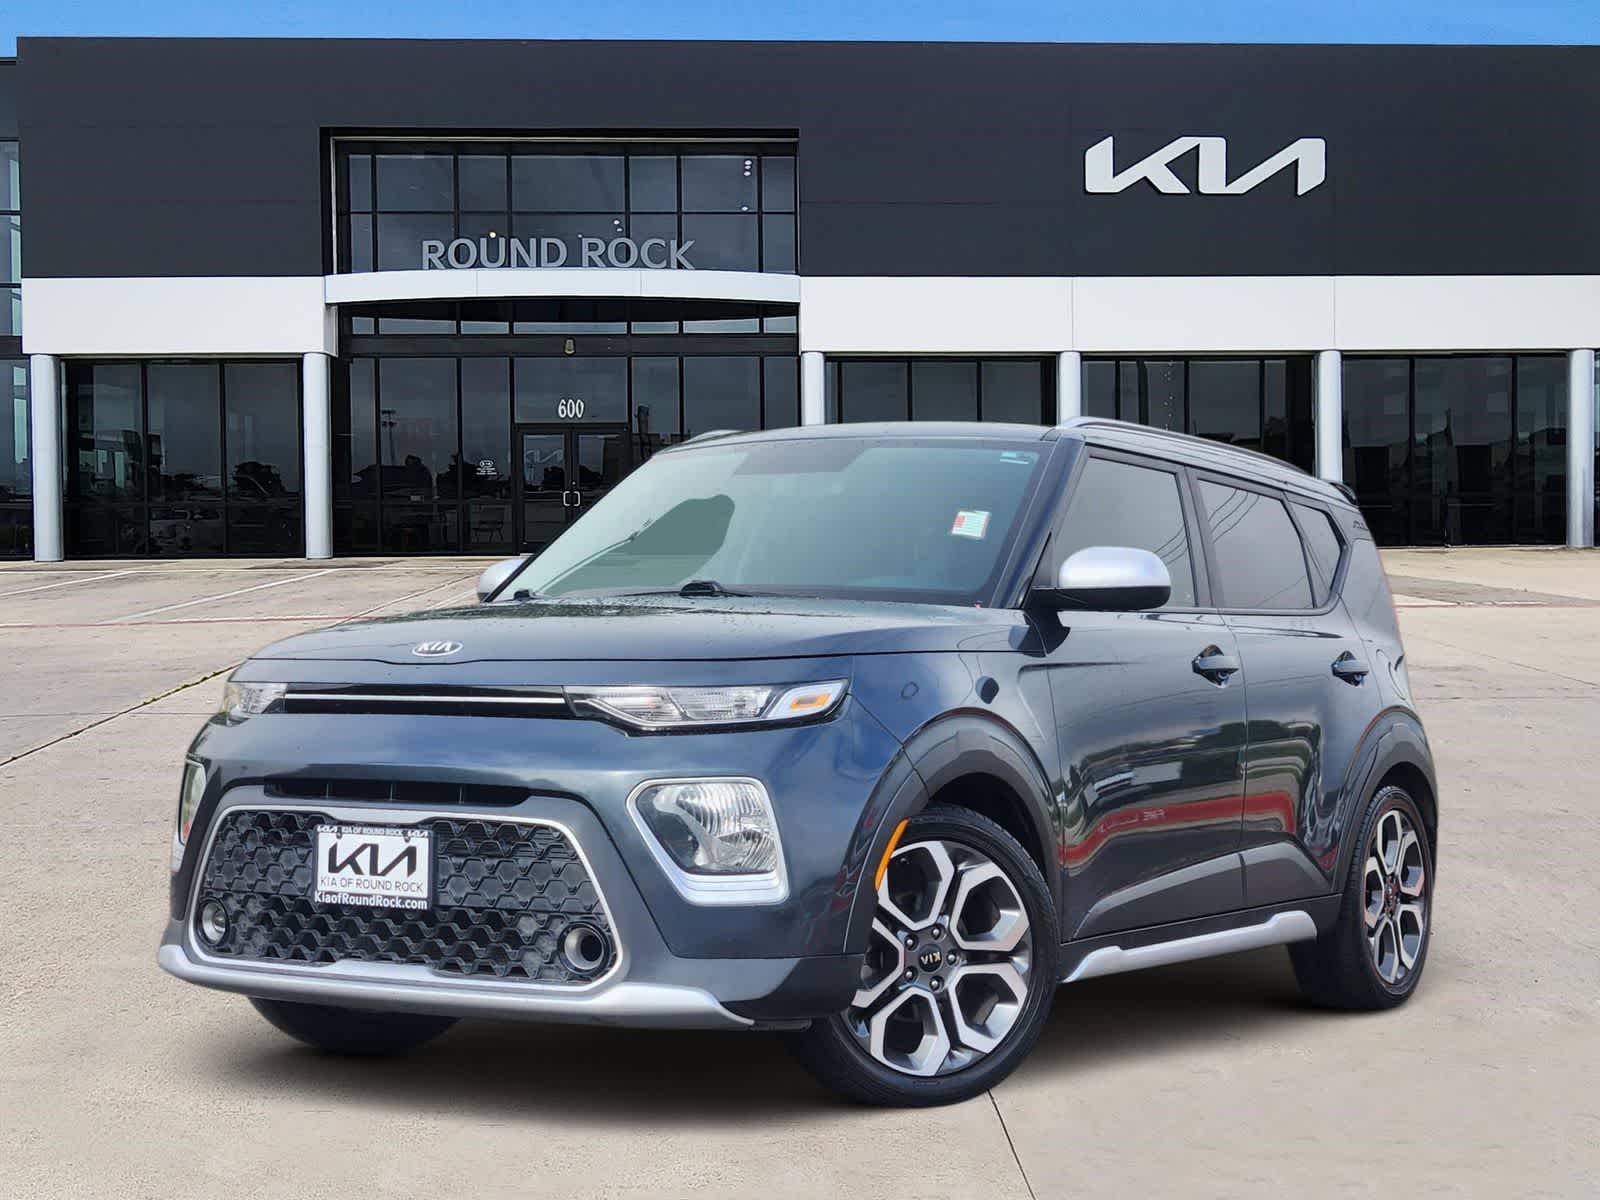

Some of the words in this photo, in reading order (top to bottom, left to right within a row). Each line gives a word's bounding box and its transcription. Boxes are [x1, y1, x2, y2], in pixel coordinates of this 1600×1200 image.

[1085, 135, 1326, 196] KIA
[422, 237, 567, 269] ROUND
[581, 238, 695, 269] ROCK
[558, 399, 584, 418] 600
[418, 641, 452, 651] KIA
[328, 841, 417, 878] KIA
[320, 877, 338, 887] KIA
[340, 878, 353, 888] OF
[355, 879, 392, 891] ROUND
[395, 881, 423, 893] ROCK
[314, 890, 428, 910] KiaofRoundRock.com
